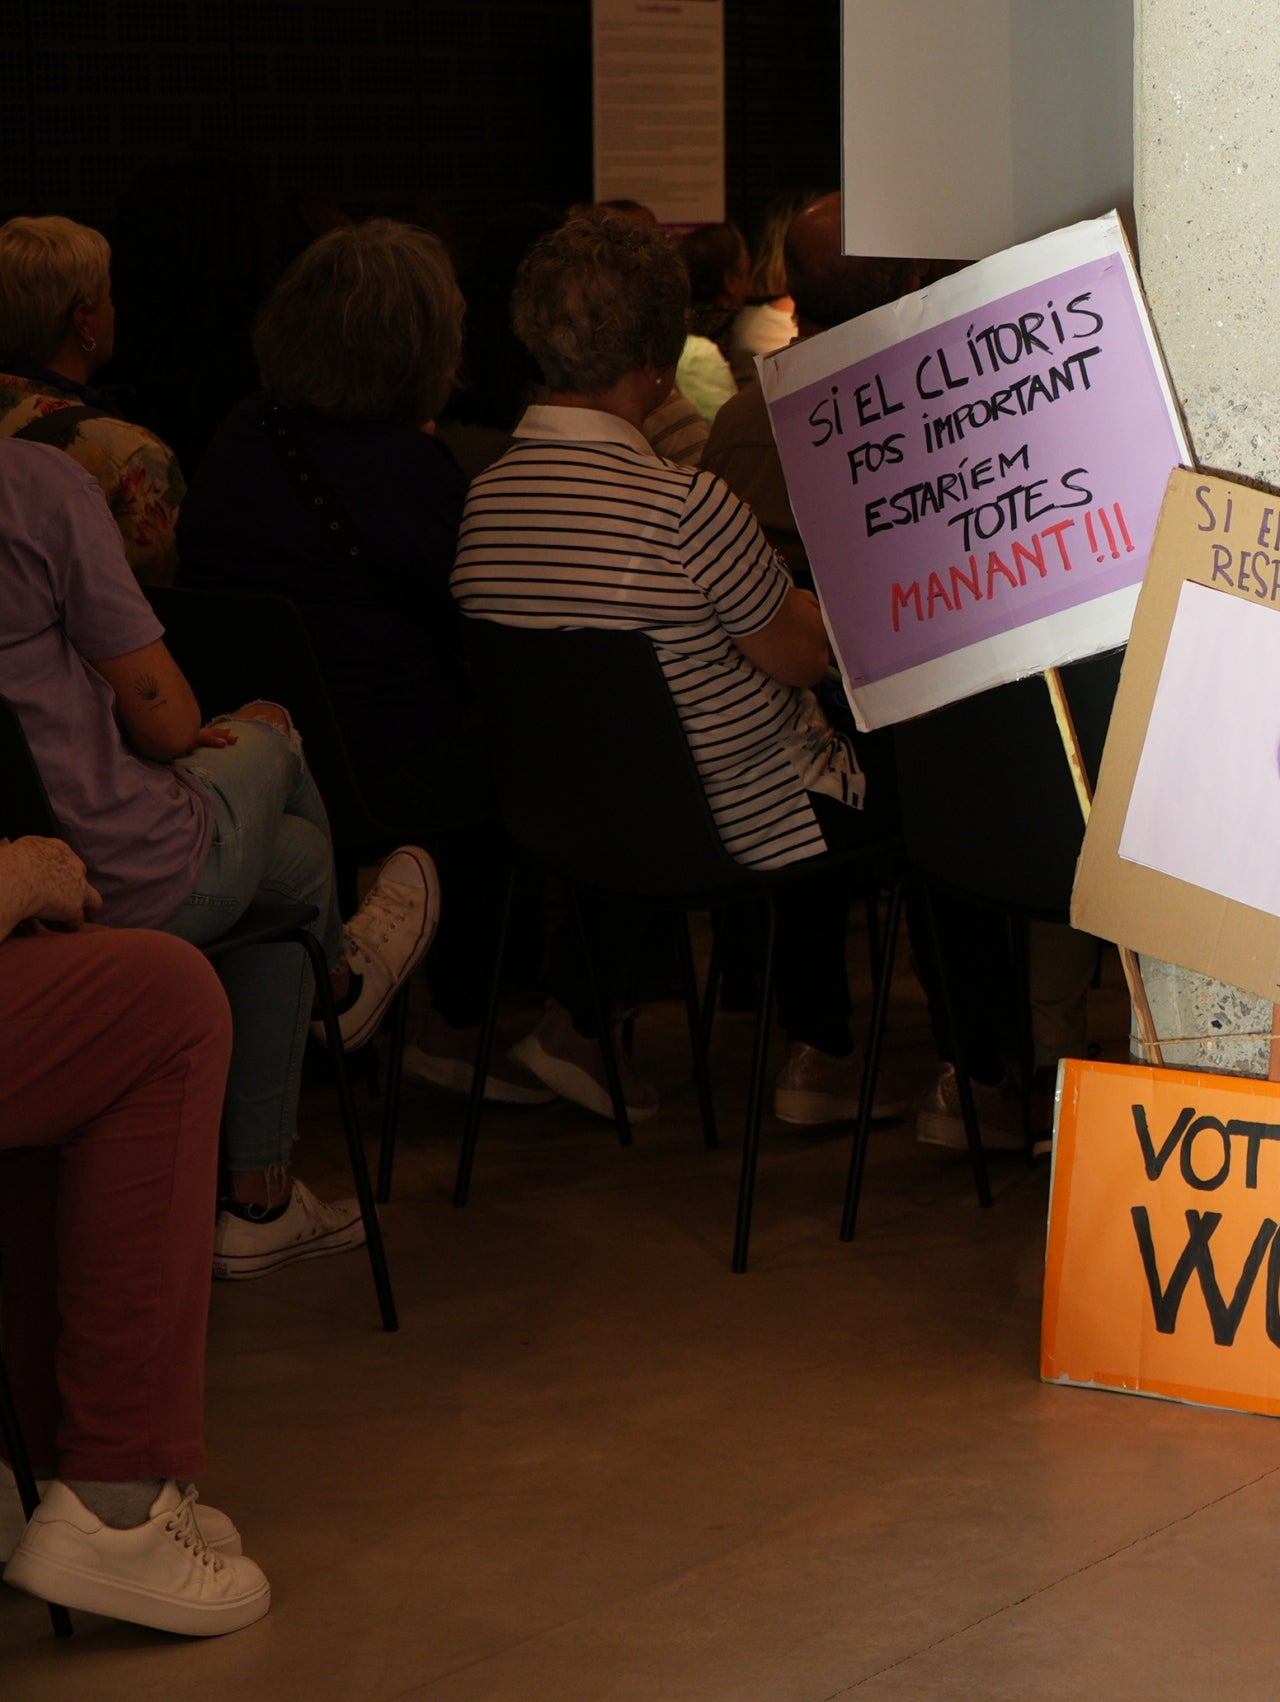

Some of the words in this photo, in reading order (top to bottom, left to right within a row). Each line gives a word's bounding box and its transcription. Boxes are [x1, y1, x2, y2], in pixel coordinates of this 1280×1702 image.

[853, 374, 905, 427] EL
[847, 433, 906, 485] FOS
[865, 444, 1030, 537] ESTARÍEM
[948, 467, 1093, 552] TOTES
